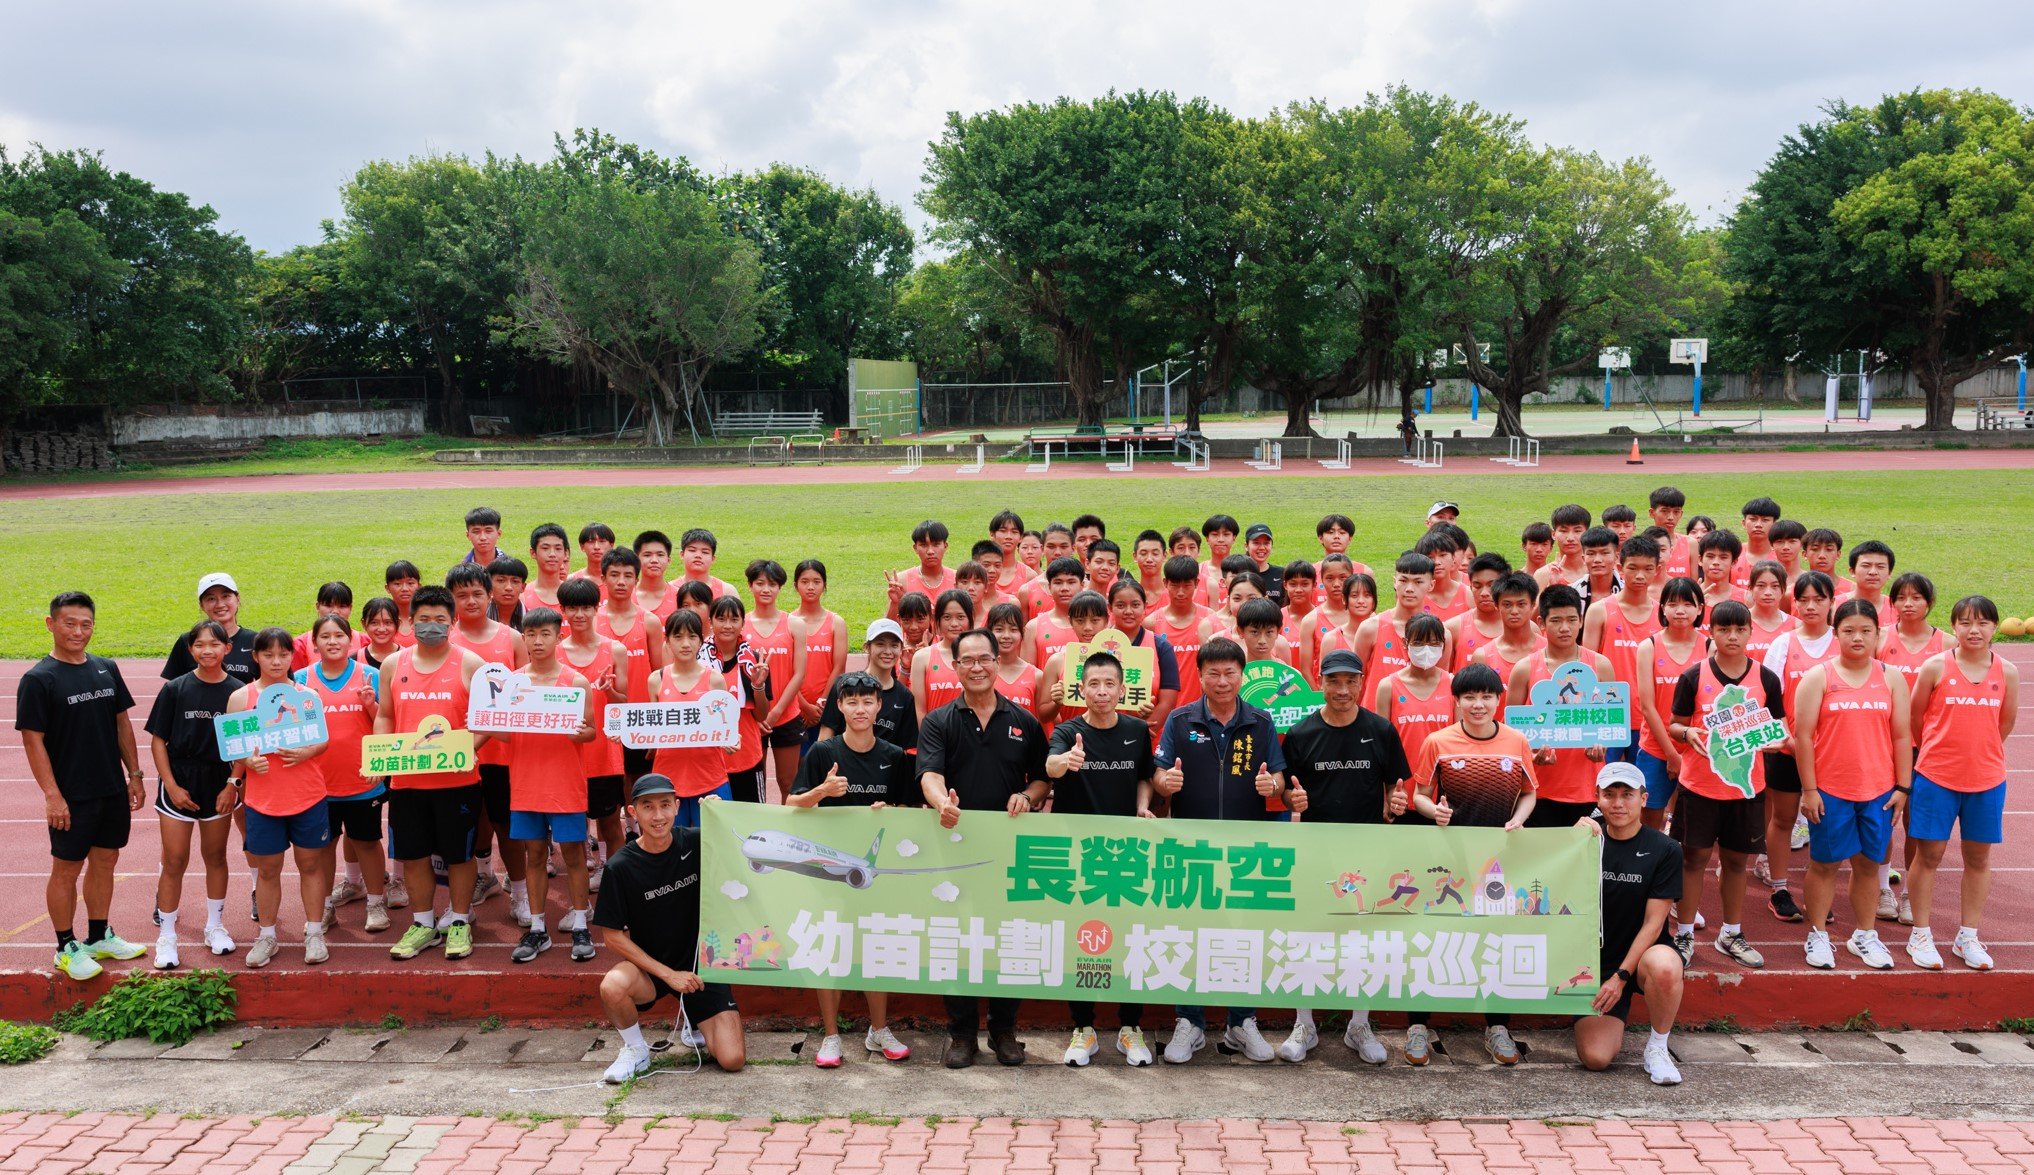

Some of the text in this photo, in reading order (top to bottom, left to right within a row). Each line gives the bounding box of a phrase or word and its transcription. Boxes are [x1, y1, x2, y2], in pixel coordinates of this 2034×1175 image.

[67, 688, 115, 705] EVA AIR
[400, 692, 452, 700] EVA AIR
[1945, 696, 2001, 707] EVA AIR
[338, 703, 363, 713] AIR
[1829, 701, 1888, 711] EVA AIR
[185, 711, 212, 719] EVA
[474, 710, 578, 730] 讓田徑更好玩
[627, 707, 701, 727] 挑戰自我
[1398, 713, 1449, 724] EVA AIR
[1705, 708, 1733, 728] 校園
[1718, 709, 1771, 738] 深耕巡迴
[222, 715, 260, 738] 養成
[1518, 726, 1627, 742] 少年揪團一起跑
[225, 723, 321, 756] 運動好習慣
[629, 729, 731, 745] You can do it !
[1724, 721, 1786, 756] 台東站
[370, 751, 466, 771] 幼苗計劃 2.0
[1081, 760, 1135, 770] EVA AIR
[1315, 760, 1371, 771] EVA AIR
[847, 784, 888, 794] VA AIR
[1006, 834, 1296, 911] 長榮航空
[1617, 872, 1643, 883] AIR
[645, 873, 698, 901] EVA AIR
[787, 908, 1065, 987] 幼苗計劃
[1077, 962, 1111, 971] MARATHON
[1122, 923, 1549, 1000] 校園深耕巡迴
[1076, 971, 1111, 989] 2023
